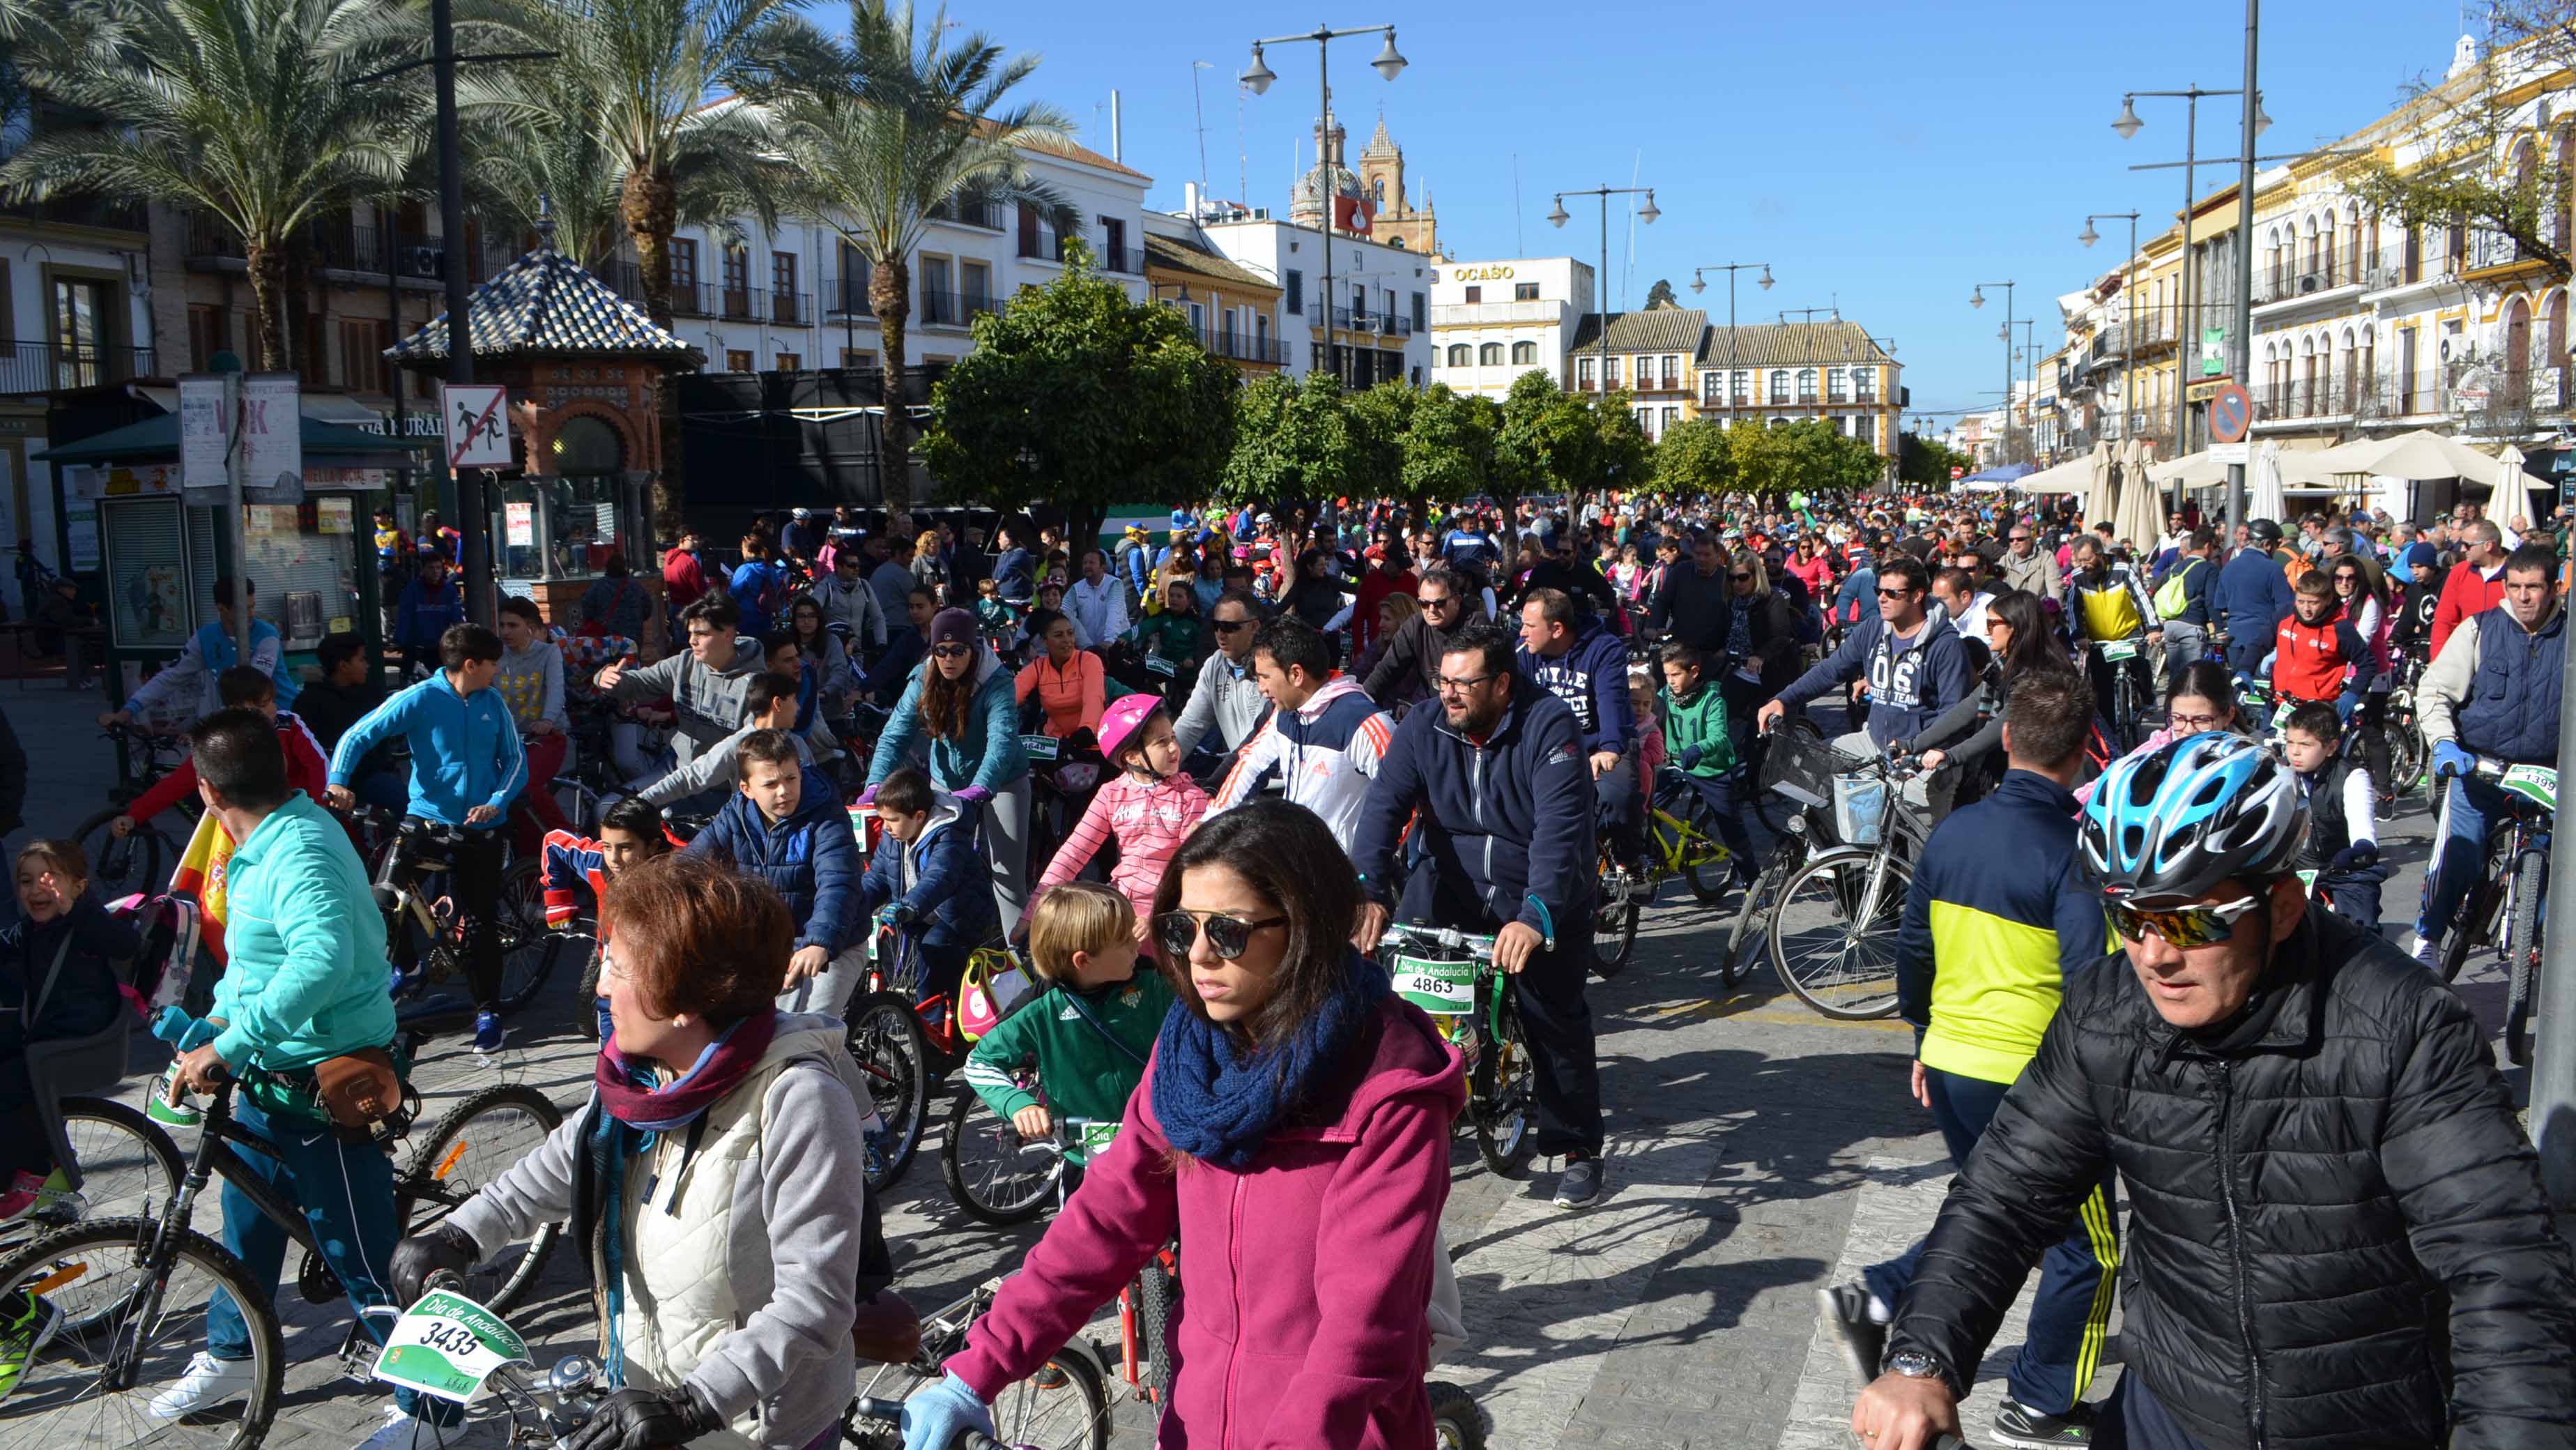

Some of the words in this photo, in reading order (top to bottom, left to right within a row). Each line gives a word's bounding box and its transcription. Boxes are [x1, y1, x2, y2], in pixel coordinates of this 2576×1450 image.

[1454, 265, 1515, 282] OCASO
[1894, 691, 1919, 705] TEAM
[2526, 774, 2556, 791] 1399
[1401, 961, 1413, 972] Día
[1416, 964, 1425, 975] de
[1427, 964, 1469, 977] Andalucía
[1413, 977, 1453, 993] 4863
[424, 1297, 445, 1313] Día
[445, 1304, 461, 1320] de
[461, 1308, 523, 1353] Andalucía
[420, 1322, 486, 1356] 3435
